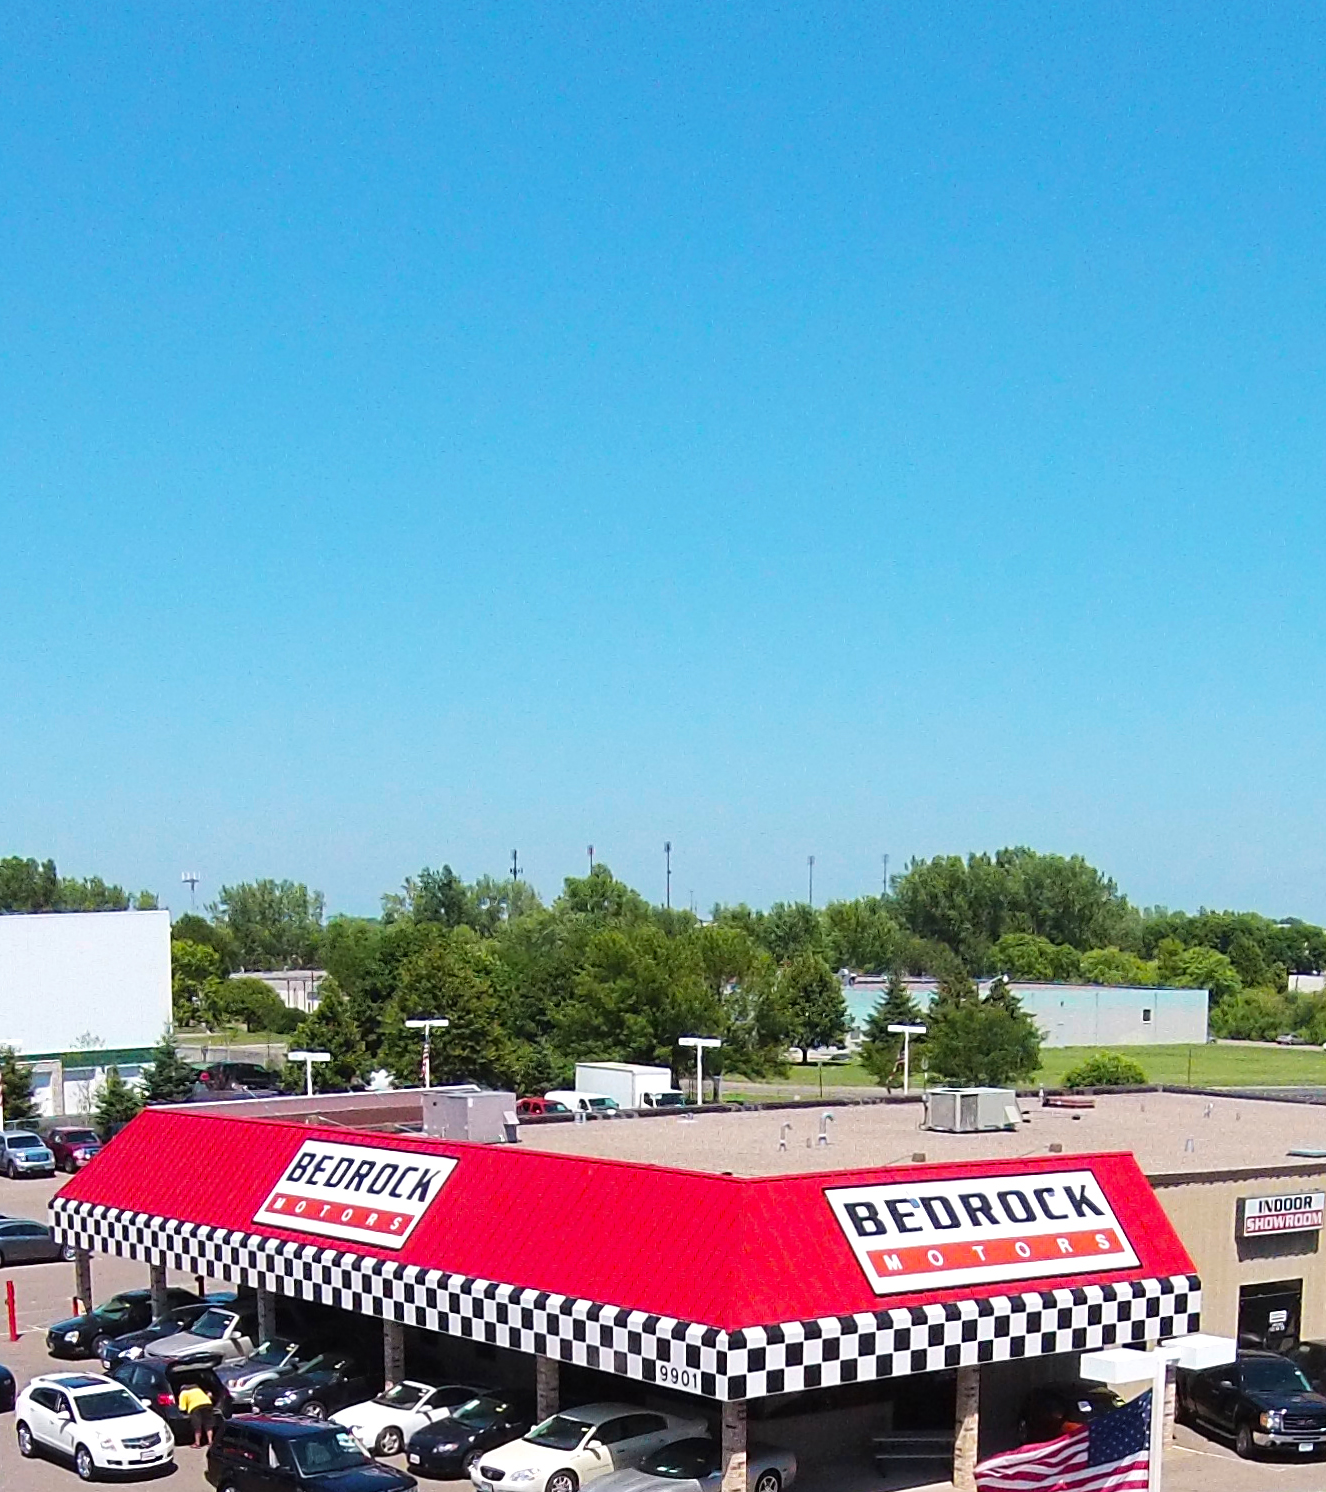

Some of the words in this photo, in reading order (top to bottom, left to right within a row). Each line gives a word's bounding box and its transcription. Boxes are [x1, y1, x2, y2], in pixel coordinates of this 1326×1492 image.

[285, 1151, 441, 1202] BEDROCK
[273, 1197, 403, 1231] MOTORS
[844, 1184, 1106, 1238] BEDROCK
[1246, 1211, 1323, 1232] SHOWROOM
[1258, 1196, 1312, 1214] INDOOR
[882, 1234, 1110, 1271] MOTORS
[660, 1364, 697, 1389] 9901
